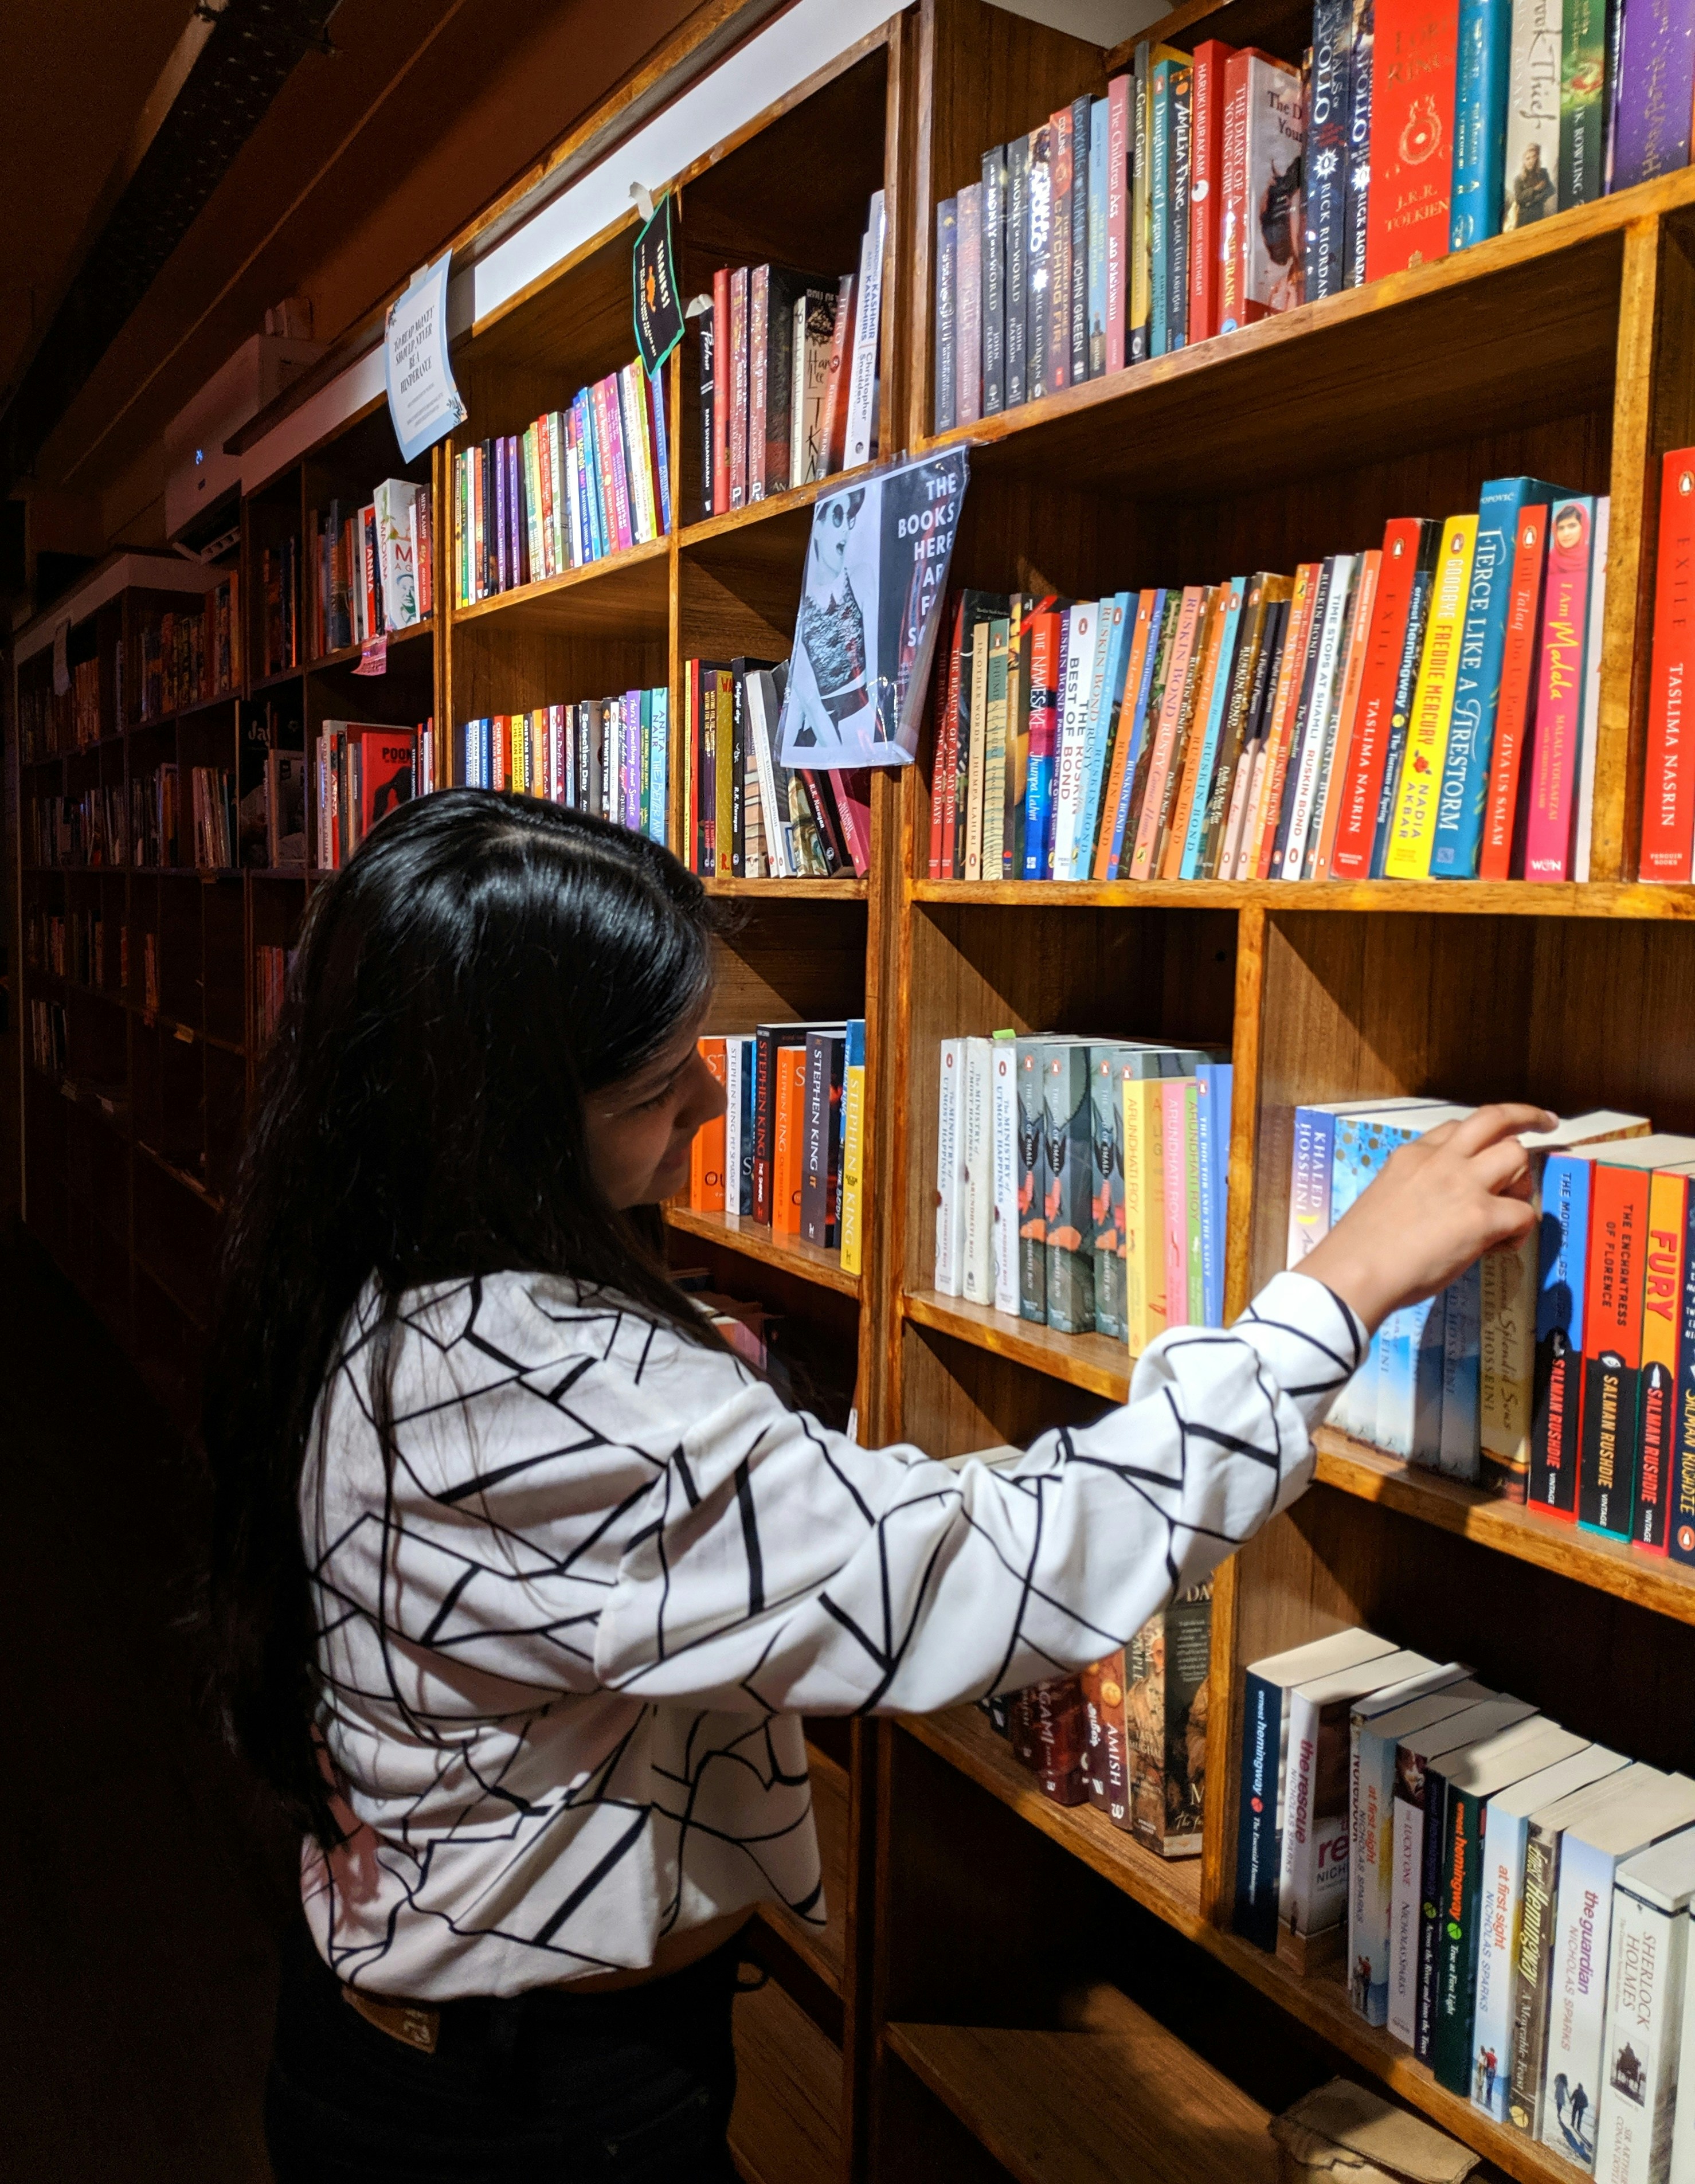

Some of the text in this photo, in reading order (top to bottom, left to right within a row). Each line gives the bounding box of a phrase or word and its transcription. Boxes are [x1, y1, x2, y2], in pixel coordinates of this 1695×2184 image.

[1267, 91, 1290, 115] The
[1314, 8, 1332, 124] APOLLO
[1352, 49, 1369, 143] APOLLO
[1058, 116, 1066, 155] COLLINS
[1110, 131, 1122, 191] Children
[1133, 93, 1145, 178] Great Gatsby
[1153, 101, 1166, 182] Daughters
[1196, 63, 1207, 177] HARUKI MURAKAMI
[1223, 102, 1234, 194] YOUNG GIRL
[1233, 86, 1246, 191] THE DIARY OF
[1571, 127, 1585, 195] ROWLING
[1012, 178, 1021, 302] MONEY WORLD
[1356, 192, 1367, 229] RICK
[1385, 197, 1450, 232] TOLKIEN
[1395, 183, 1438, 212] J.R.R.
[1054, 200, 1062, 305] CATCHING
[1195, 242, 1203, 296] SWEETHEART
[1317, 182, 1332, 299] RICK RIORDAN
[400, 325, 414, 348] READ
[415, 305, 434, 332] MONEY
[835, 297, 847, 345] HERO
[859, 276, 872, 342] KASHMIRIS
[866, 284, 878, 340] KASHMIR
[989, 259, 997, 311] WORLD
[1073, 260, 1084, 353] JOHN GREEN
[396, 323, 433, 366] SHOULD NEVER
[409, 351, 420, 370] BE A
[861, 350, 874, 421] Christopher
[898, 502, 955, 539] BOOKS
[926, 472, 957, 501] THE
[914, 530, 954, 561] HERE
[1672, 536, 1690, 629] EXILE
[1029, 656, 1047, 730] NAMESAKE
[1310, 593, 1342, 739] TIME STOPS AT SHAMLI
[1395, 622, 1421, 709] hemingway
[1416, 558, 1463, 746] GOODBYE FREDDIE MERCURY
[1438, 527, 1507, 832] FIERCE LIKE A FIRESTORM
[1546, 621, 1580, 702] Malala
[1065, 657, 1080, 737] BEST OF
[581, 713, 589, 768] Selection
[628, 725, 637, 766] Something
[652, 760, 663, 782] THE
[1060, 746, 1074, 800] BOND
[1154, 722, 1172, 769] RUSTY
[1348, 698, 1381, 833] TASLIMA NASRIN
[1660, 663, 1684, 827] TASLIMA NASRIN
[813, 797, 825, 829] Narayan
[1294, 749, 1316, 837] RUSKIN BOND
[1398, 781, 1416, 839] AKBAR
[1411, 784, 1430, 839] NADIA
[1491, 733, 1514, 847] ZIYA US SALAM
[757, 1040, 768, 1157] STEPHEN KING
[778, 1061, 788, 1153] STEPHEN KING
[809, 1048, 823, 1172] STEPHEN KING
[847, 1079, 859, 1173] STEPHEN
[995, 1086, 1004, 1203] UTMOST HAPPINESS
[1003, 1115, 1011, 1182] MINISTRY
[1127, 1098, 1139, 1214] ARUNDHATI ROY
[1167, 1098, 1180, 1224] ARUNDHATI ROY
[1188, 1101, 1199, 1193] ARUNDHATI
[1295, 1122, 1312, 1211] HOSSEINI
[1310, 1131, 1326, 1208] KHALED
[1559, 1172, 1572, 1199] THE
[844, 1192, 856, 1246] KING
[1602, 1221, 1616, 1309] OF FLORENCE
[1616, 1204, 1634, 1327] THE ENCHANTRESS
[1646, 1229, 1678, 1322] FURY
[1484, 1330, 1495, 1412] HOSSEINI
[1546, 1357, 1565, 1469] SALMAN RUSHDIE
[1597, 1375, 1619, 1490] SALMAN RUSHDIE
[1641, 1387, 1663, 1505] SALMAN RUSHDIE
[1680, 1388, 1695, 1516] SALMAN RUSHDIE
[1547, 1472, 1556, 1505] VINTAGE
[1599, 1493, 1608, 1528] VINTAGE
[1643, 1509, 1653, 1544] VINTAGE
[1106, 1721, 1122, 1787] AMISH
[1252, 1690, 1268, 1796] ernest hemingway
[1285, 1767, 1298, 1874] NICHOLAS SPARKS
[1294, 1737, 1315, 1845] the rescue
[1353, 1872, 1365, 1924] SPARKS
[1449, 1837, 1468, 1923] hemingway
[1492, 1864, 1510, 1951] at first sight
[1399, 1900, 1410, 1960] NICHOLAS
[1479, 1890, 1494, 2012] NICHOLAS SPARKS
[1517, 1878, 1550, 1989] Hemingway
[1577, 1889, 1600, 1996] the guardian
[1622, 1933, 1642, 2010] HOLMES
[1559, 1924, 1579, 2053] NICHOLAS SPARKS
[1636, 1931, 1657, 2032] SHERLOCK
